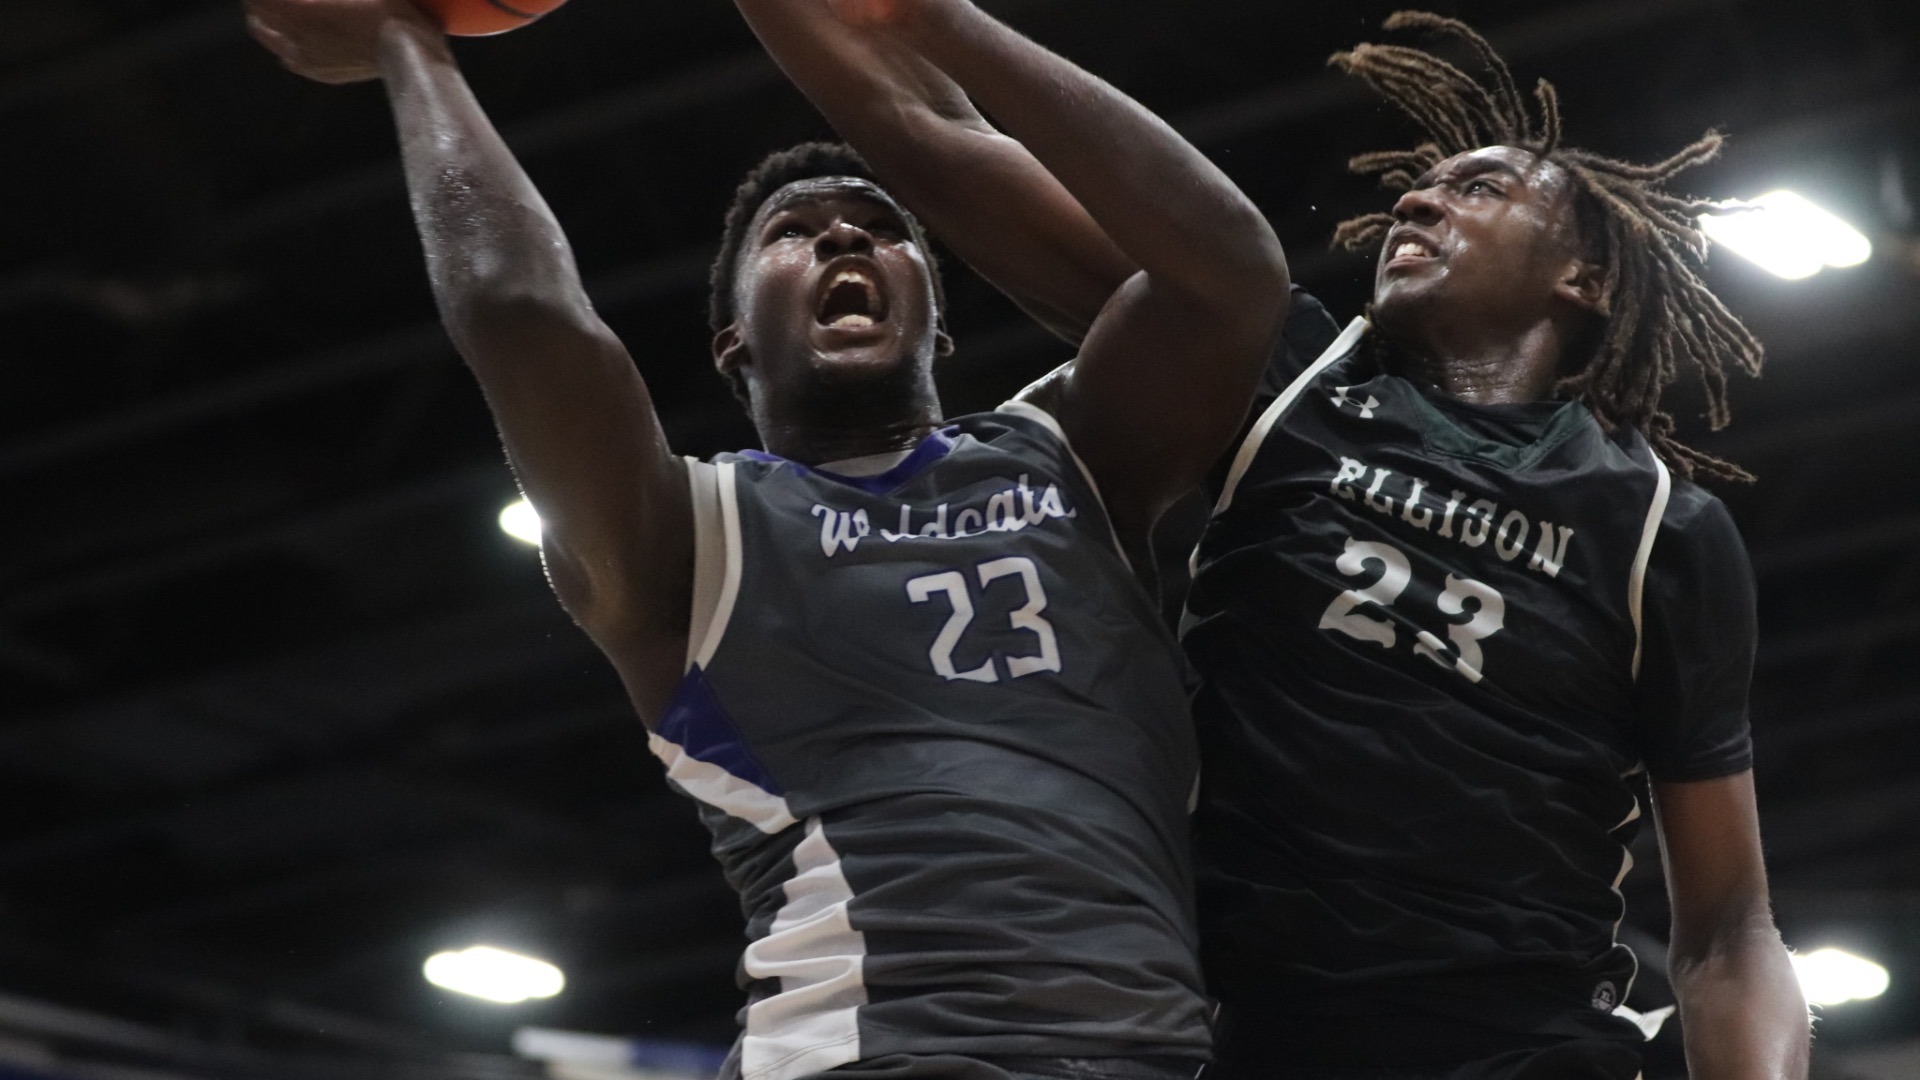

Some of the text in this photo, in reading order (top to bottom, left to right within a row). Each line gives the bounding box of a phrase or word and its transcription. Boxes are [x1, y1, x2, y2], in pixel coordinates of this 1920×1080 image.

[811, 474, 1077, 557] Wldcats
[1330, 456, 1575, 579] ELLISON
[906, 556, 1062, 683] 23
[1318, 535, 1506, 684] 23
